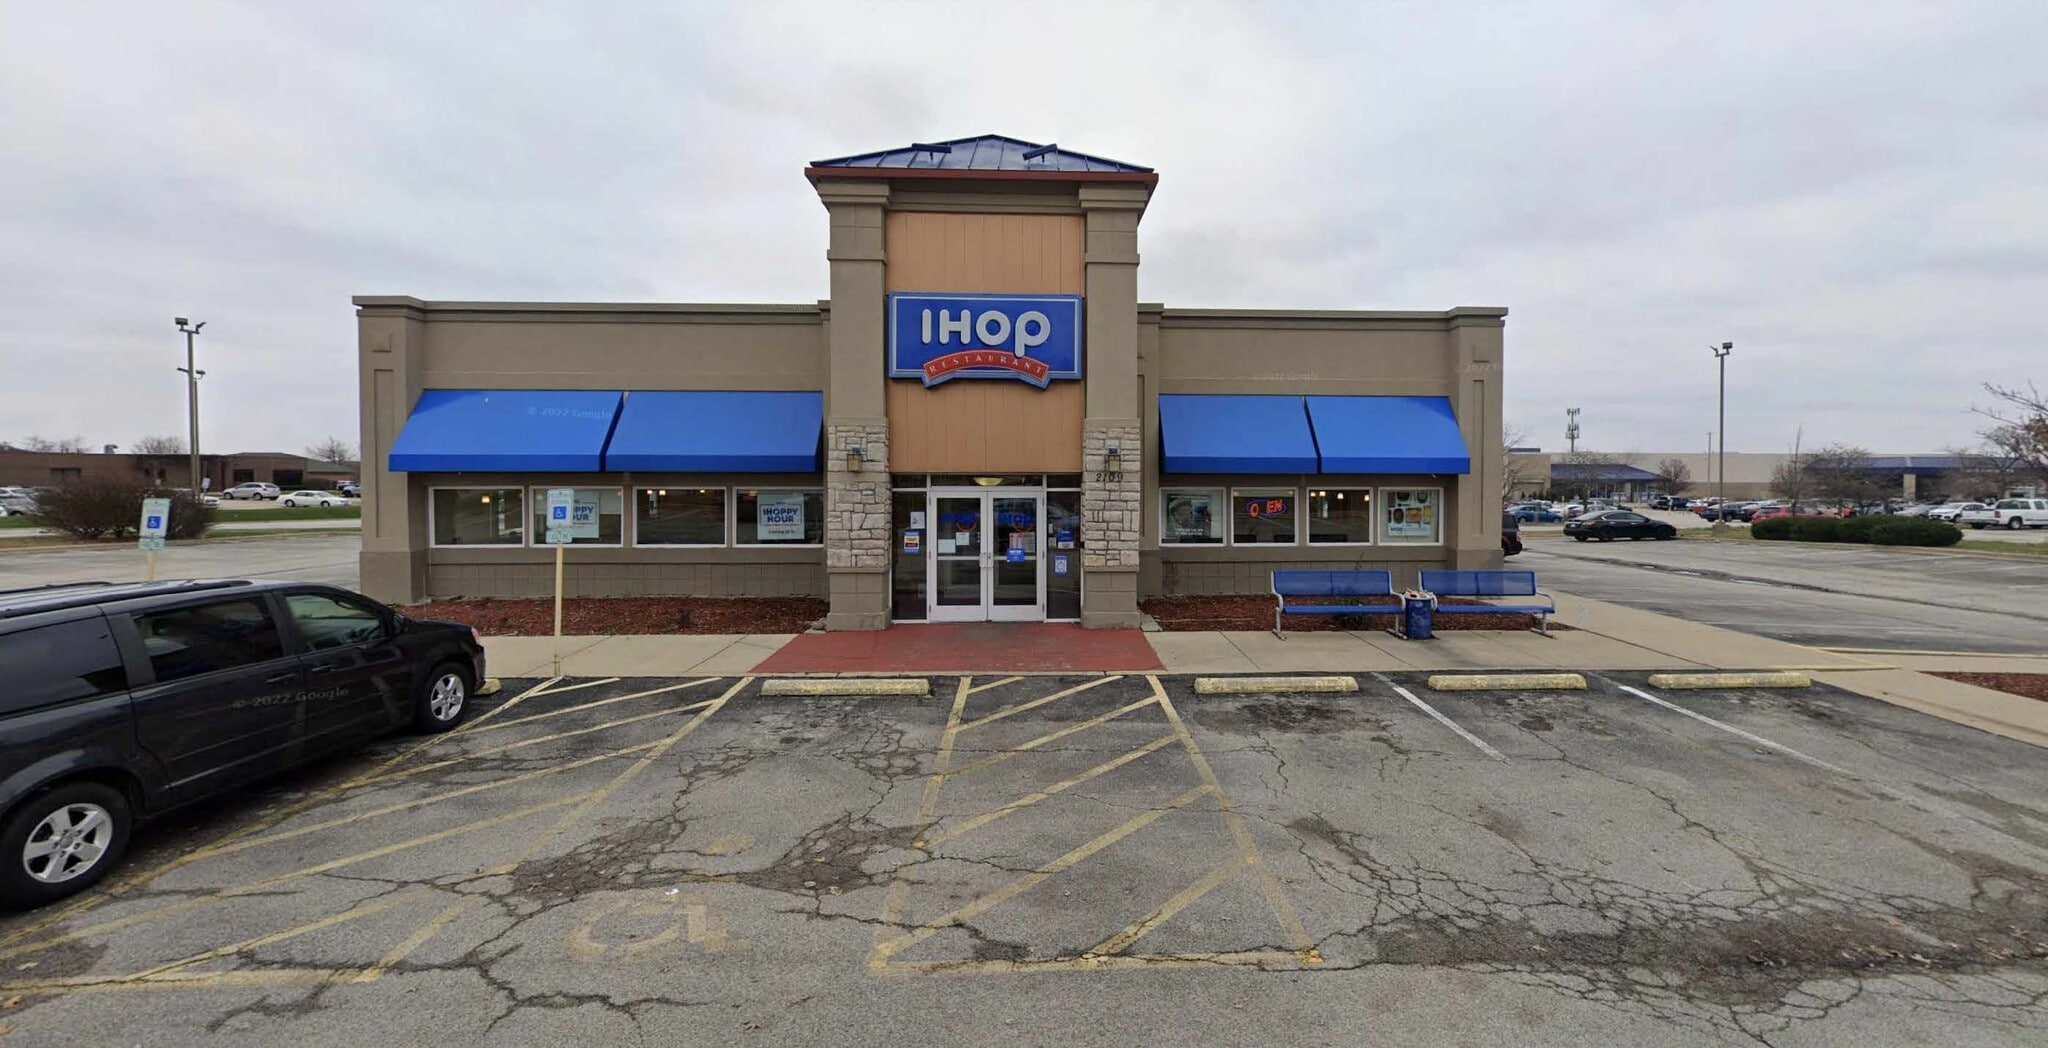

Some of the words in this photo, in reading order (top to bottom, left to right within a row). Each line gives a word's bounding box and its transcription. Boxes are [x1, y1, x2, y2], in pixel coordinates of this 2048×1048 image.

[921, 308, 1051, 358] IHOP
[928, 353, 1044, 374] RESTAURANT
[763, 507, 798, 515] IHOPPY
[767, 515, 794, 523] HOUR
